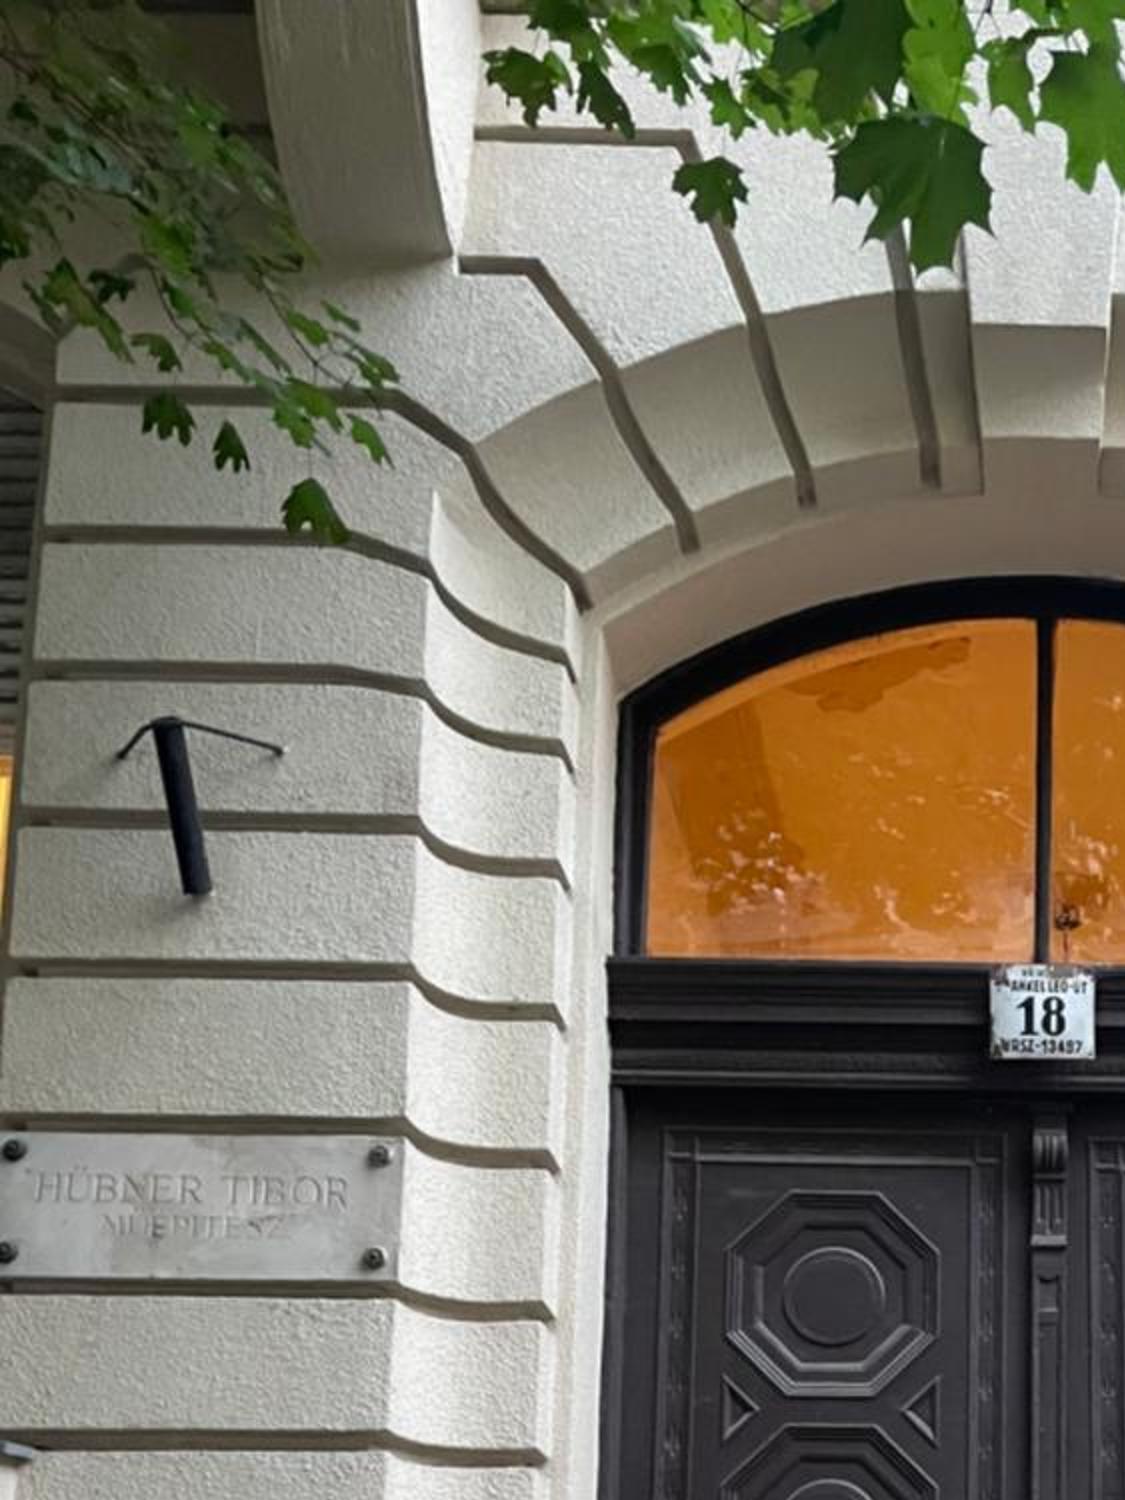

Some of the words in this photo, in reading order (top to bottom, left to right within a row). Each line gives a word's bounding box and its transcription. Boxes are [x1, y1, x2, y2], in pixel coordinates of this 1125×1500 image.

[1016, 995, 1066, 1036] 18
[35, 1163, 203, 1204] HÜBNER
[221, 1172, 349, 1209] TIBOR
